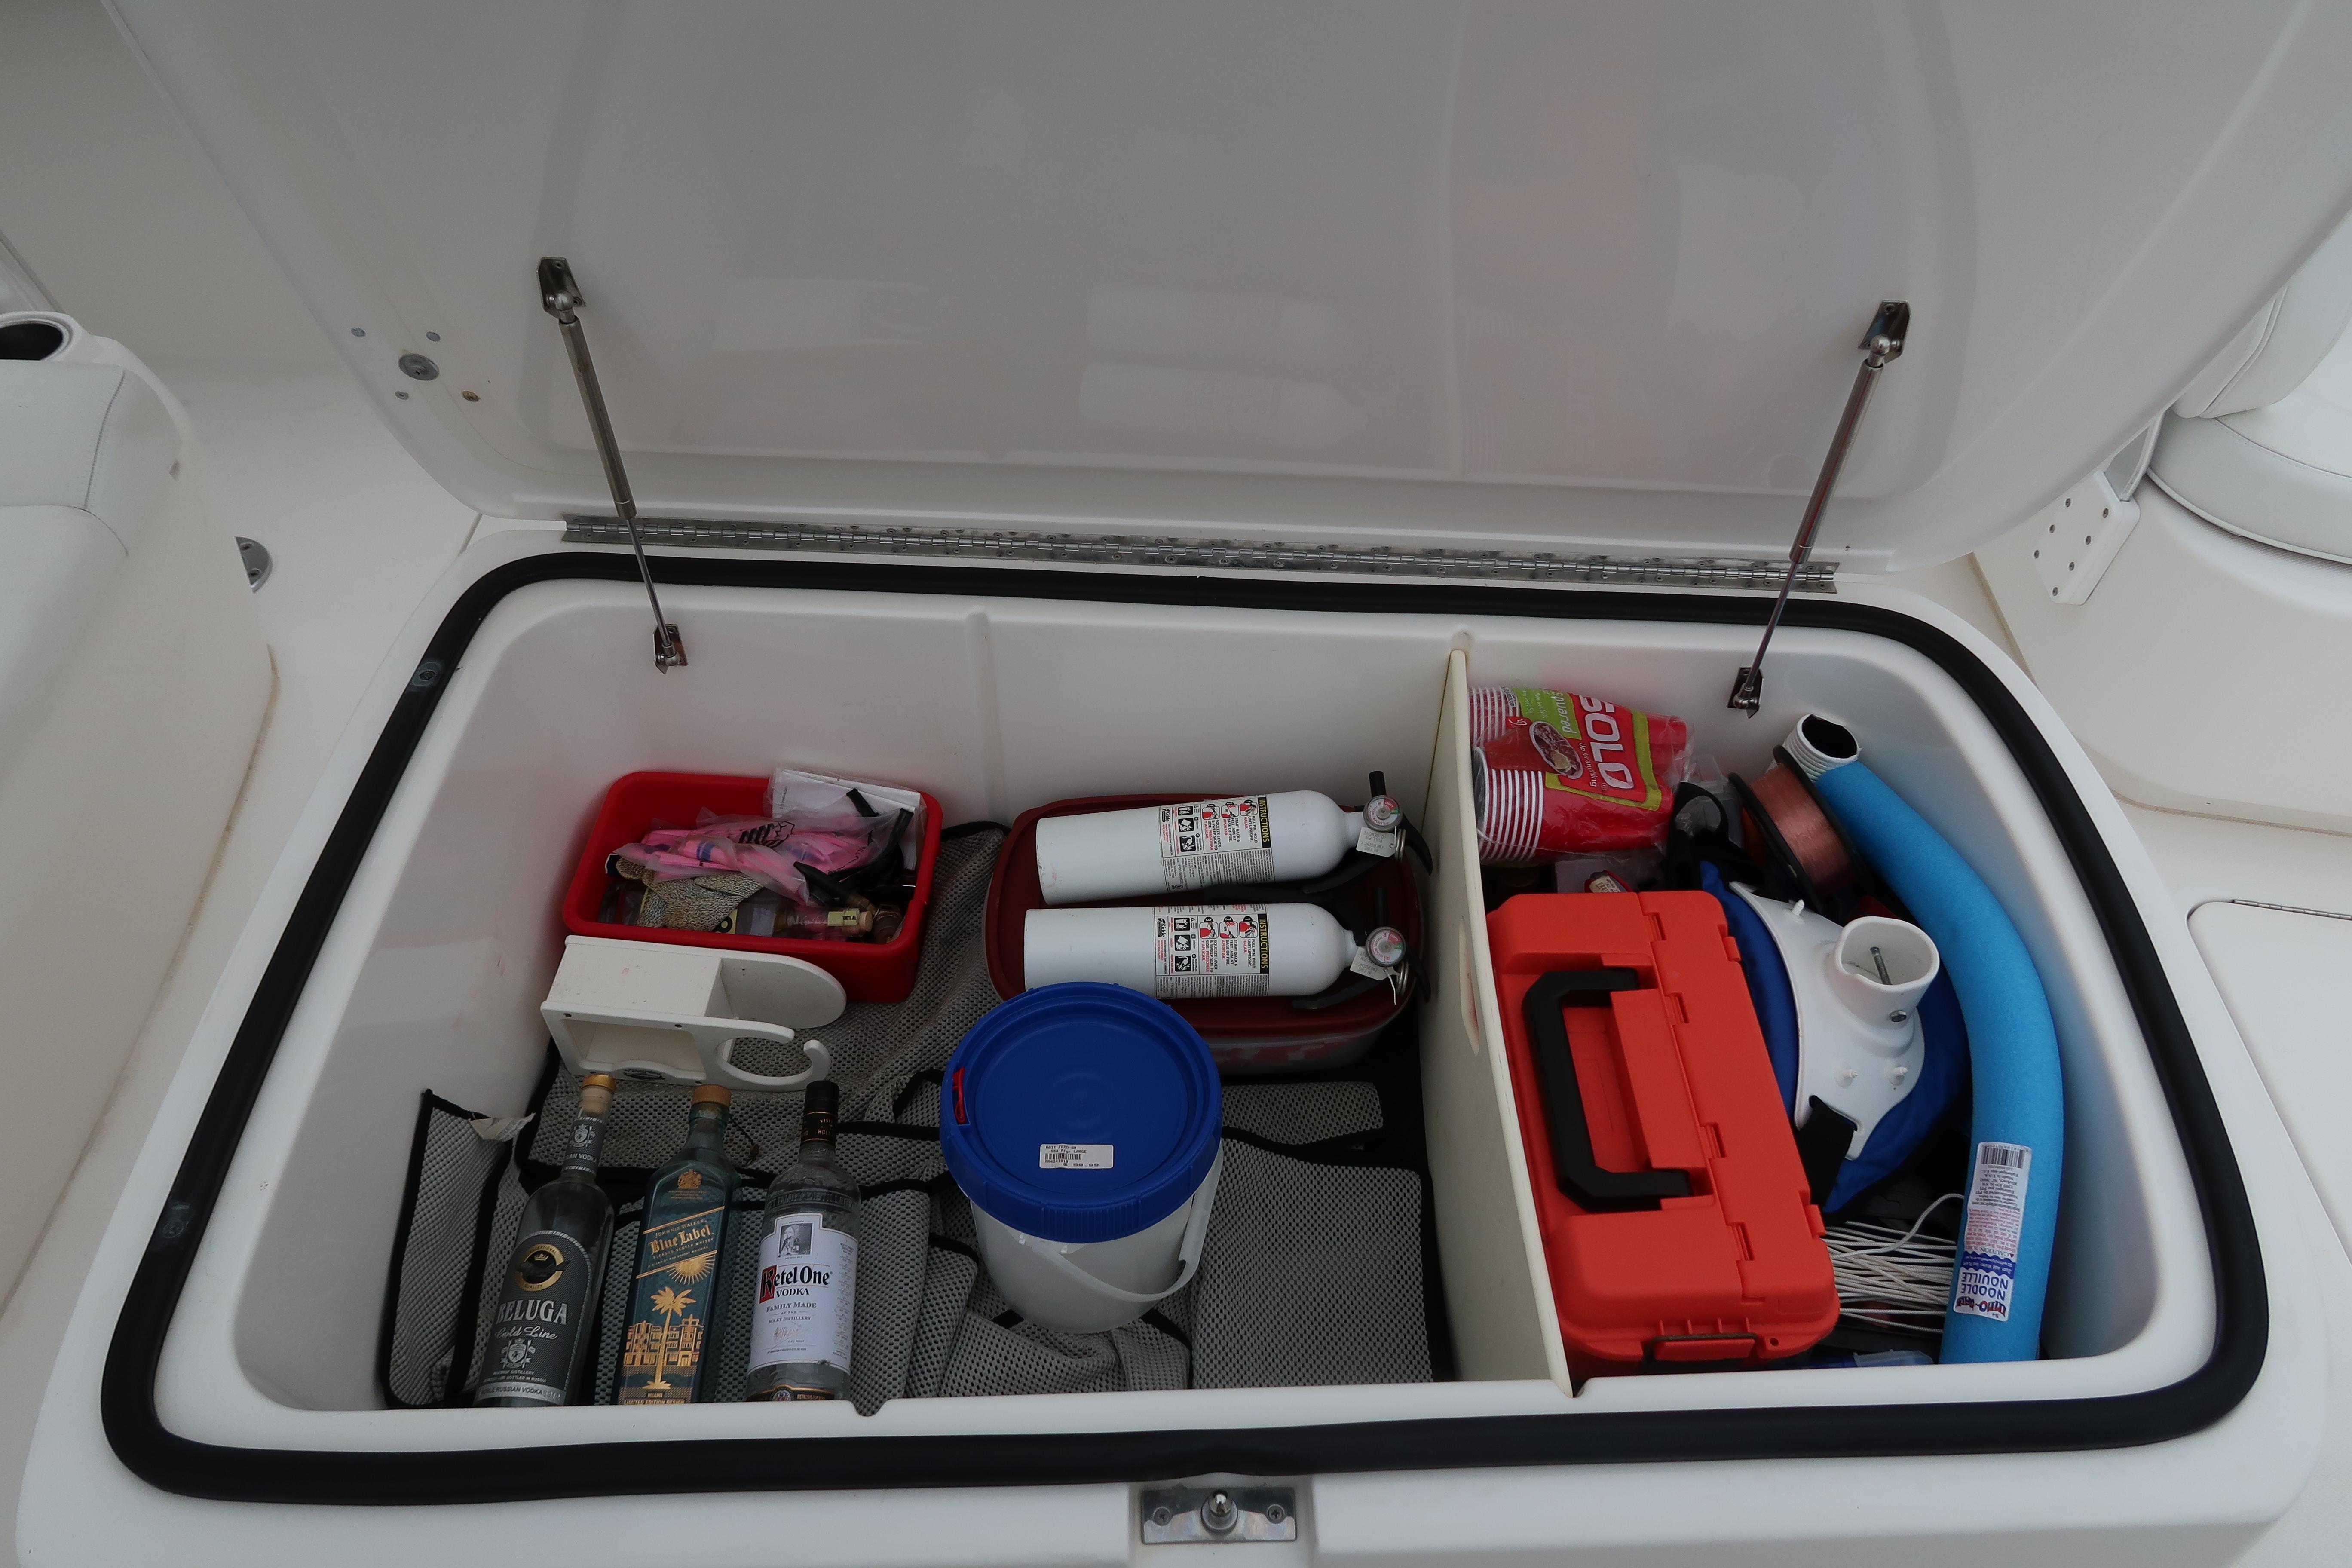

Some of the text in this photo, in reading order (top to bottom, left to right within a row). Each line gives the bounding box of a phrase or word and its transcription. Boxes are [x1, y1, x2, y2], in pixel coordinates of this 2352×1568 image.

[1579, 695, 1634, 789] SOLO
[1579, 742, 1586, 752] Up
[1258, 799, 1270, 842] INSTRUCTIONS
[1259, 918, 1268, 969] INSTRUCTIONS
[655, 1226, 680, 1238] JOHNNIE
[648, 1237, 678, 1256] Blue
[653, 1237, 714, 1259] BLENDED SCOTCH WHISKY
[761, 1265, 830, 1298] Ketel One
[1961, 1272, 2008, 1289] NOUILLE
[776, 1288, 810, 1298] VODKA
[1961, 1283, 2006, 1301] NOODLE
[496, 1299, 567, 1325] BELUGA
[766, 1302, 793, 1313] FAMILY
[495, 1326, 558, 1339] Gold Line
[522, 1387, 542, 1395] VODKA
